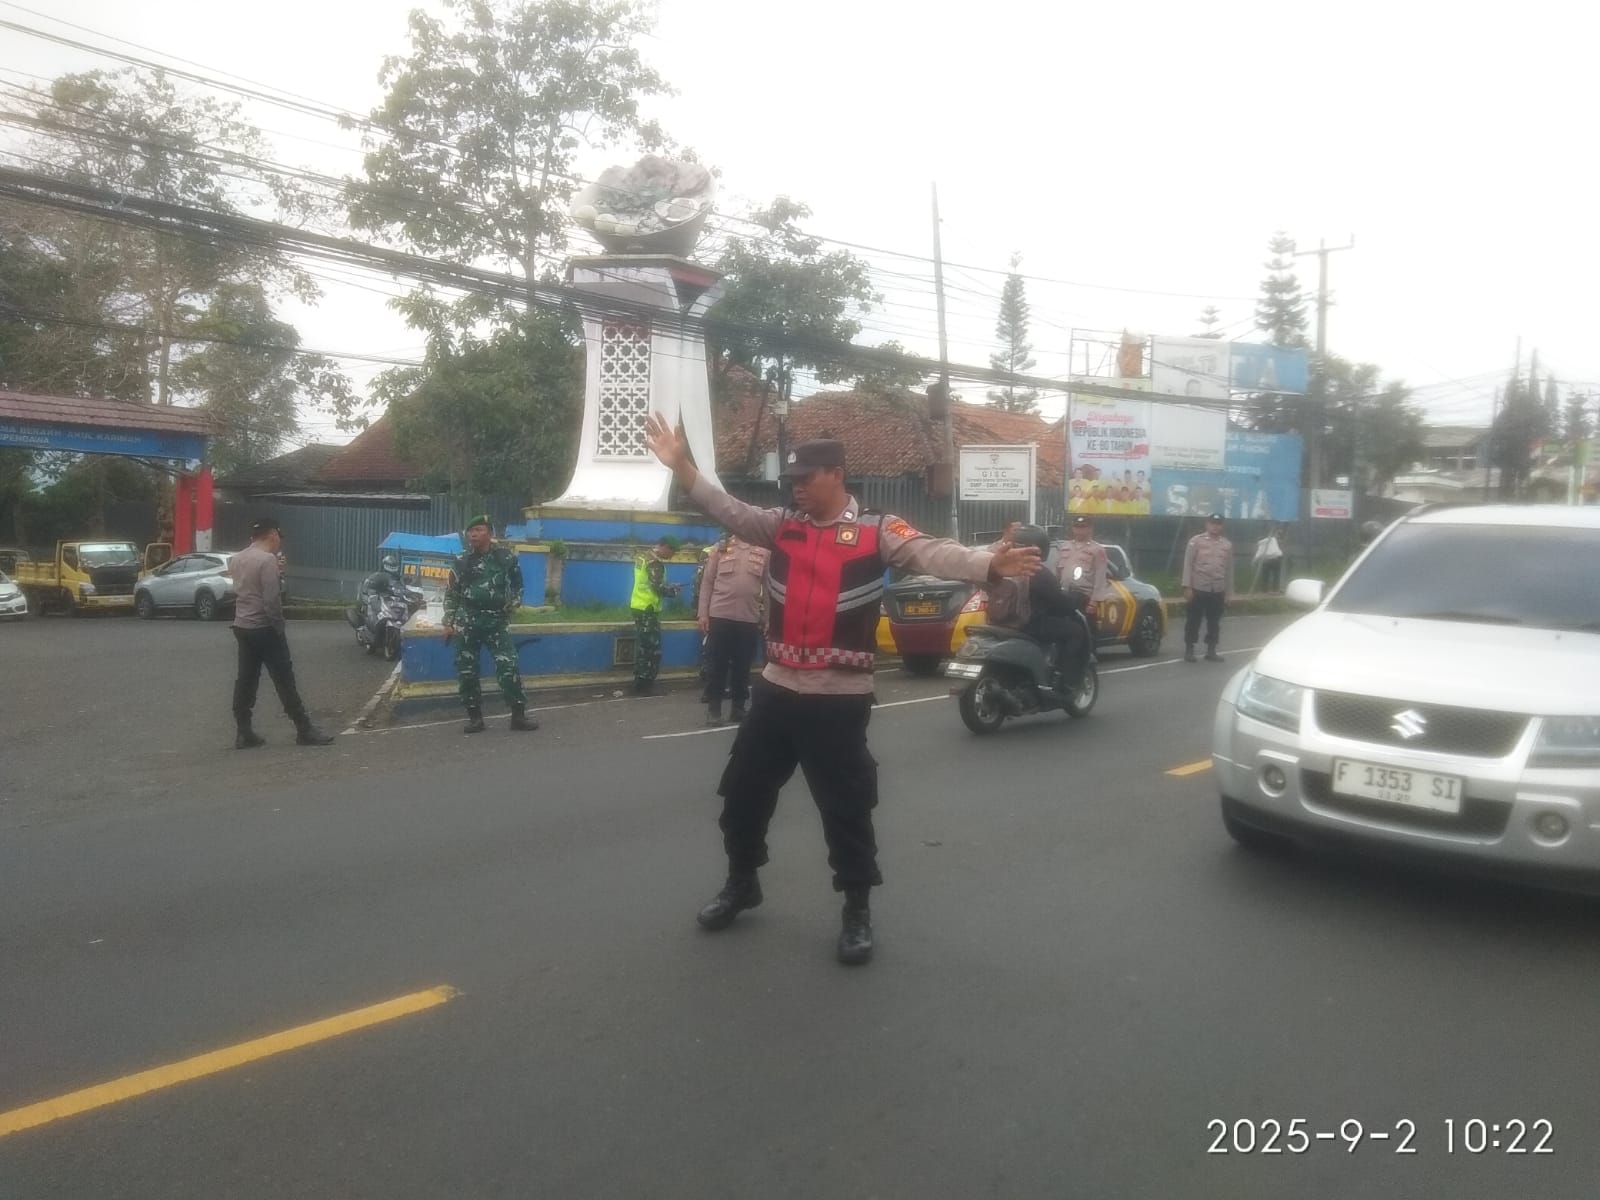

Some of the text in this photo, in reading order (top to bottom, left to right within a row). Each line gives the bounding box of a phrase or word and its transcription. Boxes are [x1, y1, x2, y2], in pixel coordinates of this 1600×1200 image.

[1337, 762, 1350, 781] F
[1364, 767, 1412, 792] 1353
[1431, 777, 1456, 800] SI
